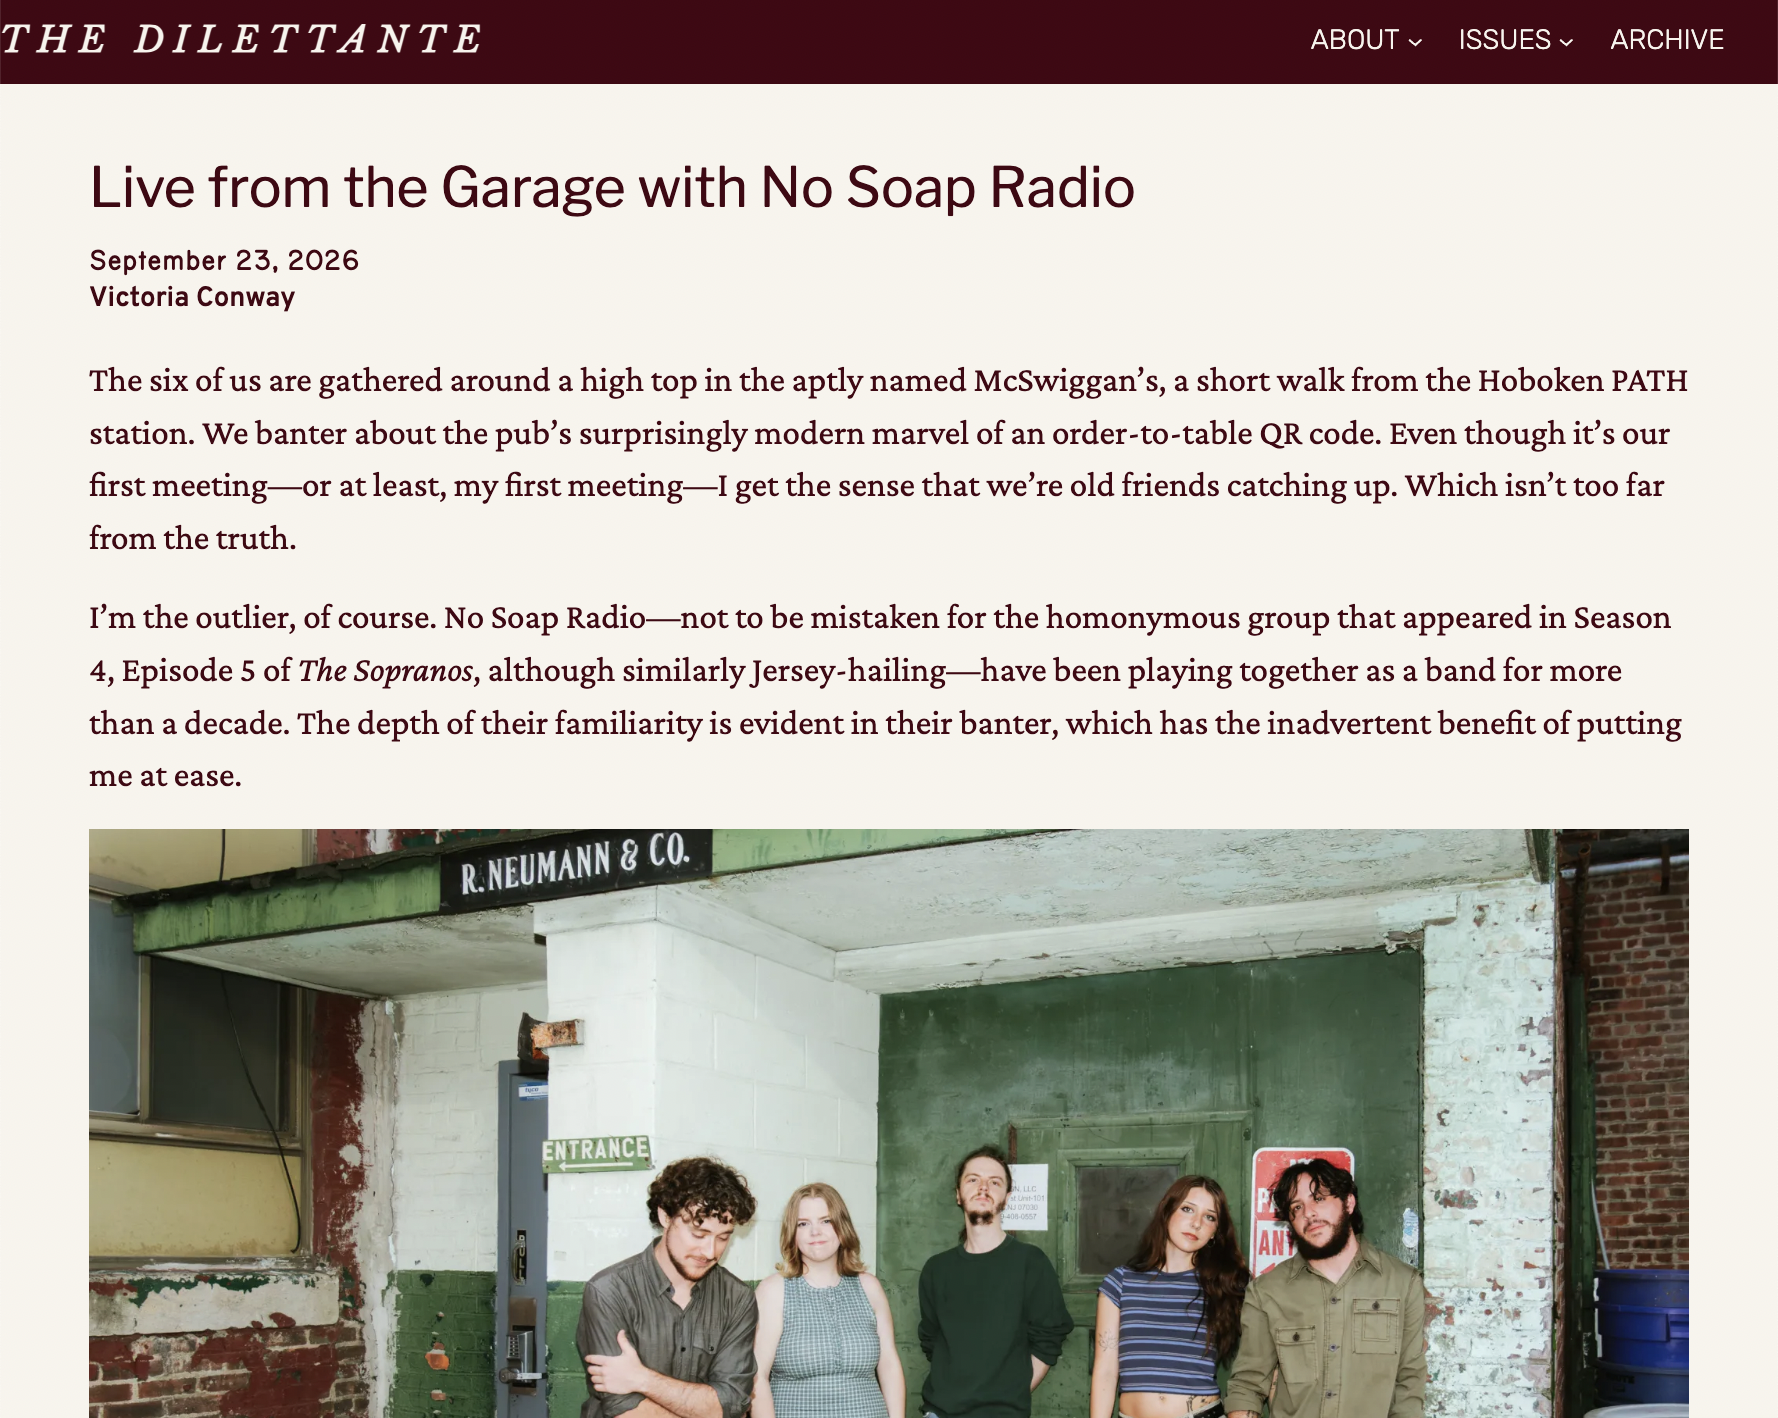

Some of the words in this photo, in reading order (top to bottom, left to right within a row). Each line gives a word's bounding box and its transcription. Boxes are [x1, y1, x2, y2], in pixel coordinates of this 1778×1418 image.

[1, 23, 106, 54] THE
[132, 23, 481, 54] DILETTANTE
[1310, 28, 1400, 51] ABOUT
[1460, 28, 1552, 51] ISSUES
[1610, 28, 1725, 51] ARCHIVE
[93, 164, 195, 209] Live
[207, 164, 329, 209] from
[343, 164, 428, 209] the
[442, 164, 625, 218] Garage
[638, 164, 745, 208] with
[763, 164, 833, 209] No
[847, 164, 976, 217] Soap
[992, 164, 1135, 209] Radio
[90, 248, 227, 276] September
[236, 248, 279, 274] 23,
[288, 248, 359, 271] 2026
[89, 285, 189, 308] Victoria
[196, 285, 296, 313] Conway
[88, 366, 143, 392] The
[149, 367, 189, 392] six
[195, 365, 226, 392] of
[228, 374, 262, 393] us
[269, 374, 312, 392] are
[318, 366, 444, 400] gathered
[450, 366, 551, 393] around
[558, 374, 574, 392] a
[579, 366, 645, 400] high
[650, 372, 698, 400] top
[704, 367, 733, 392] in
[738, 366, 785, 392] the
[792, 366, 865, 400] aptly
[869, 366, 968, 393] named
[974, 366, 1166, 400] McSwiggan’s,
[1174, 374, 1190, 392] a
[1196, 366, 1272, 392] short
[1276, 366, 1346, 392] walk
[1350, 365, 1419, 392] from
[1425, 366, 1471, 392] the
[1478, 366, 1605, 392] Hoboken
[1611, 369, 1688, 392] PATH
[89, 420, 195, 445] station.
[201, 422, 249, 445] We
[254, 419, 348, 445] banter
[355, 419, 437, 445] about
[442, 419, 488, 445] the
[494, 418, 572, 453] pub’s
[579, 419, 749, 453] surprisingly
[754, 419, 866, 446] modern
[871, 419, 970, 445] marvel
[976, 418, 1007, 445] of
[1011, 427, 1046, 445] an
[1052, 419, 1253, 446] order-to-table
[1260, 422, 1304, 450] QR
[1309, 419, 1382, 445] code.
[1389, 422, 1458, 445] Even
[1463, 419, 1567, 453] though
[1572, 419, 1616, 445] it’s
[1622, 427, 1671, 445] our
[88, 470, 147, 497] first
[339, 477, 368, 497] at
[372, 471, 447, 503] least,
[453, 479, 500, 505] my
[504, 470, 563, 497] first
[735, 477, 780, 505] get
[785, 471, 831, 497] the
[838, 479, 915, 497] sense
[921, 471, 981, 497] that
[985, 471, 1063, 497] we’re
[1070, 471, 1116, 498] old
[1121, 470, 1220, 497] friends
[1227, 471, 1348, 505] catching
[1353, 479, 1398, 505] up.
[1404, 471, 1499, 497] Which
[1504, 470, 1568, 497] isn’t
[1572, 477, 1619, 497] too
[1625, 470, 1666, 497] far
[88, 523, 157, 550] from
[163, 524, 209, 550] the
[215, 524, 296, 551] truth.
[89, 603, 137, 629] I’m
[142, 603, 189, 629] the
[195, 603, 296, 635] outlier,
[303, 602, 334, 629] of
[338, 611, 437, 630] course.
[444, 606, 484, 629] No
[491, 606, 559, 637] Soap
[734, 609, 764, 629] to
[769, 603, 804, 629] be
[810, 603, 941, 629] mistaken
[946, 602, 987, 629] for
[993, 603, 1039, 629] the
[1045, 603, 1241, 637] homonymous
[1247, 611, 1330, 637] group
[1336, 603, 1397, 629] that
[1403, 603, 1533, 637] appeared
[1538, 604, 1567, 629] in
[1574, 606, 1672, 629] Season
[89, 659, 115, 688] 4,
[122, 656, 233, 690] Episode
[240, 659, 256, 682] 5
[263, 655, 294, 682] of
[298, 656, 348, 682] The
[353, 659, 481, 690] Sopranos,
[488, 656, 616, 690] although
[622, 656, 747, 690] similarly
[1052, 656, 1122, 682] been
[1127, 656, 1234, 690] playing
[1239, 656, 1359, 690] together
[1366, 664, 1395, 682] as
[1402, 664, 1419, 682] a
[1423, 656, 1497, 682] band
[1502, 655, 1544, 682] for
[1549, 664, 1622, 682] more
[88, 709, 155, 735] than
[162, 717, 178, 735] a
[184, 709, 290, 736] decade.
[296, 709, 351, 735] The
[357, 709, 440, 743] depth
[446, 708, 477, 735] of
[480, 709, 549, 735] their
[554, 708, 704, 743] familiarity
[709, 710, 732, 735] is
[739, 709, 846, 735] evident
[850, 710, 879, 735] in
[885, 709, 953, 735] their
[958, 709, 1059, 741] banter,
[1065, 709, 1153, 735] which
[1159, 709, 1208, 735] has
[1214, 709, 1261, 735] the
[1267, 709, 1433, 735] inadvertent
[1436, 708, 1537, 735] benefit
[1542, 708, 1573, 735] of
[1576, 710, 1683, 743] putting
[88, 769, 133, 787] me
[140, 767, 169, 787] at
[174, 769, 242, 787] ease.
[488, 841, 610, 891] NEUMANN
[620, 838, 639, 871] &
[650, 832, 690, 867] CO.
[542, 1136, 649, 1161] ENTRANCE
[1018, 1194, 1045, 1202] Unit-101
